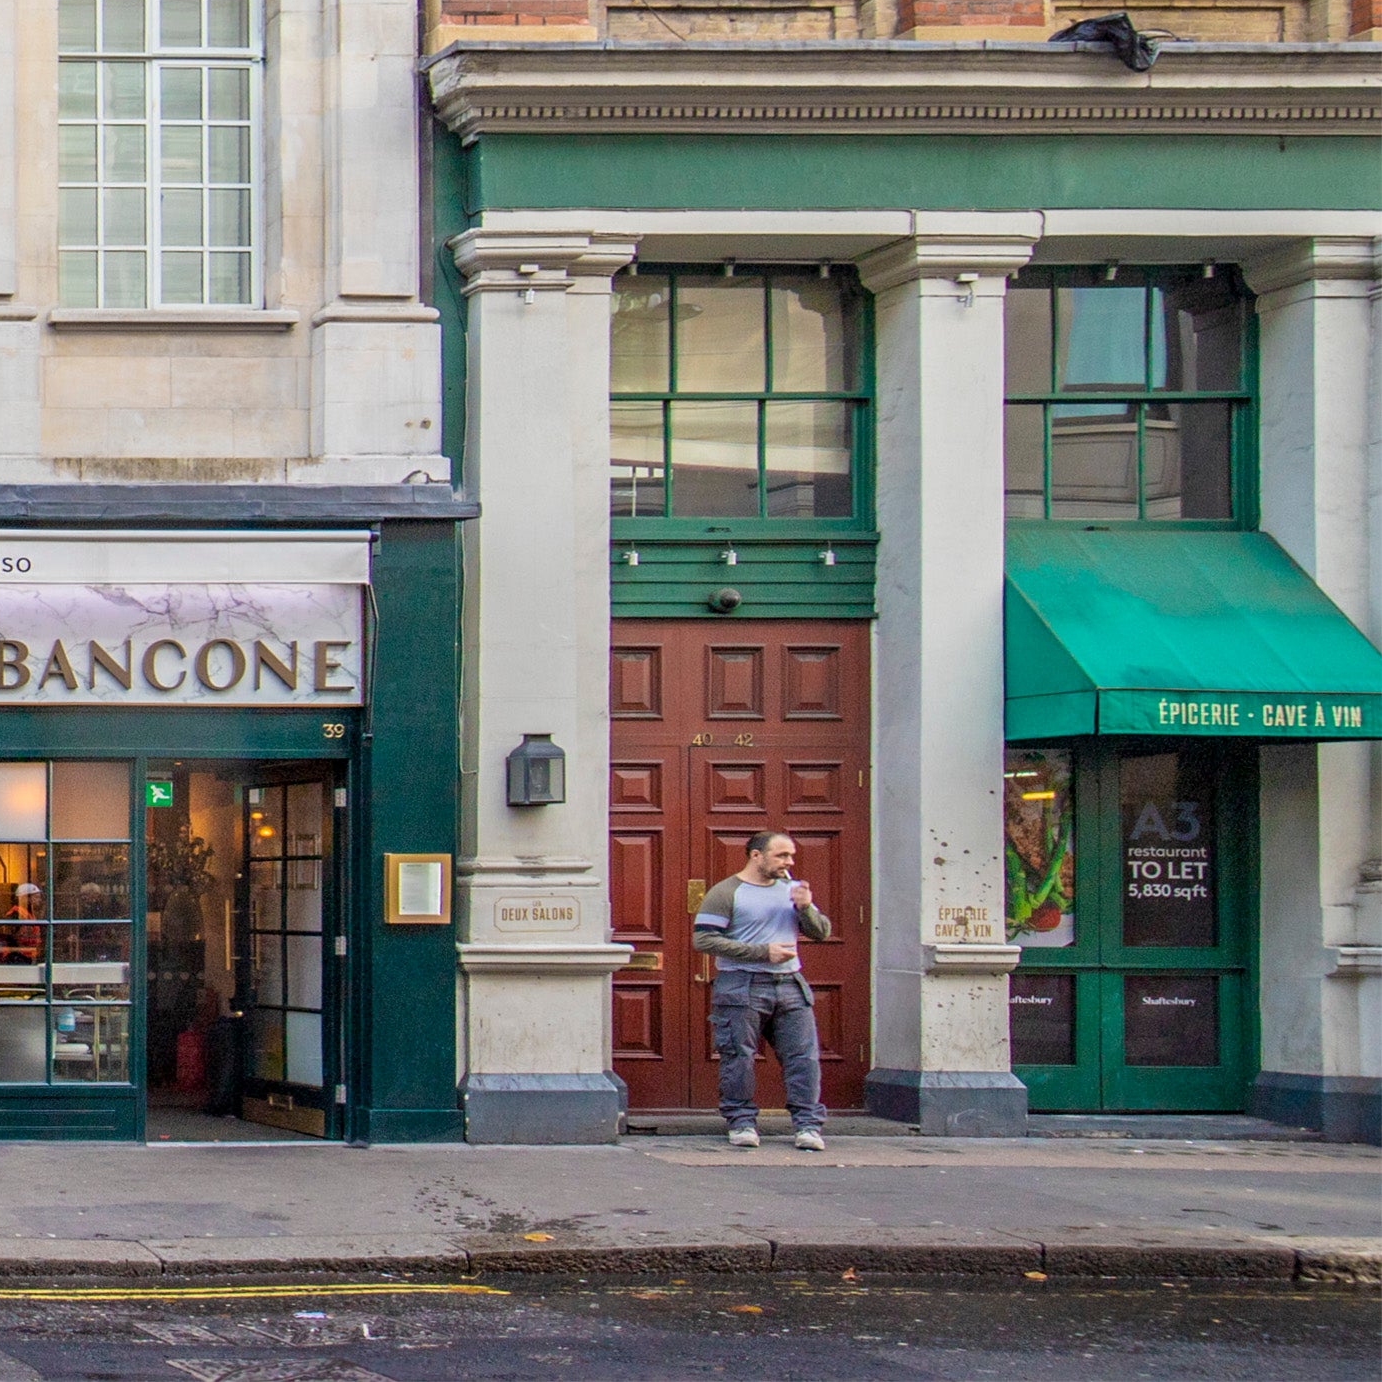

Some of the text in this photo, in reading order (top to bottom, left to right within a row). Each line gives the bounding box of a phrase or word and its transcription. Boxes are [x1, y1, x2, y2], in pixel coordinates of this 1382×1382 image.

[1159, 698, 1363, 728] ÉPICERIE CAVE À VIN
[322, 723, 345, 739] 39
[692, 732, 754, 747] 40 42
[1129, 802, 1201, 841] A3
[1128, 847, 1208, 858] restaurant
[1127, 861, 1209, 880] TO LET
[1128, 883, 1172, 899] 5,830
[501, 907, 573, 921] DEUX SALONS
[935, 924, 960, 937] CAVE
[973, 924, 992, 937] VIN
[1141, 996, 1197, 1007] Shaftesbury
